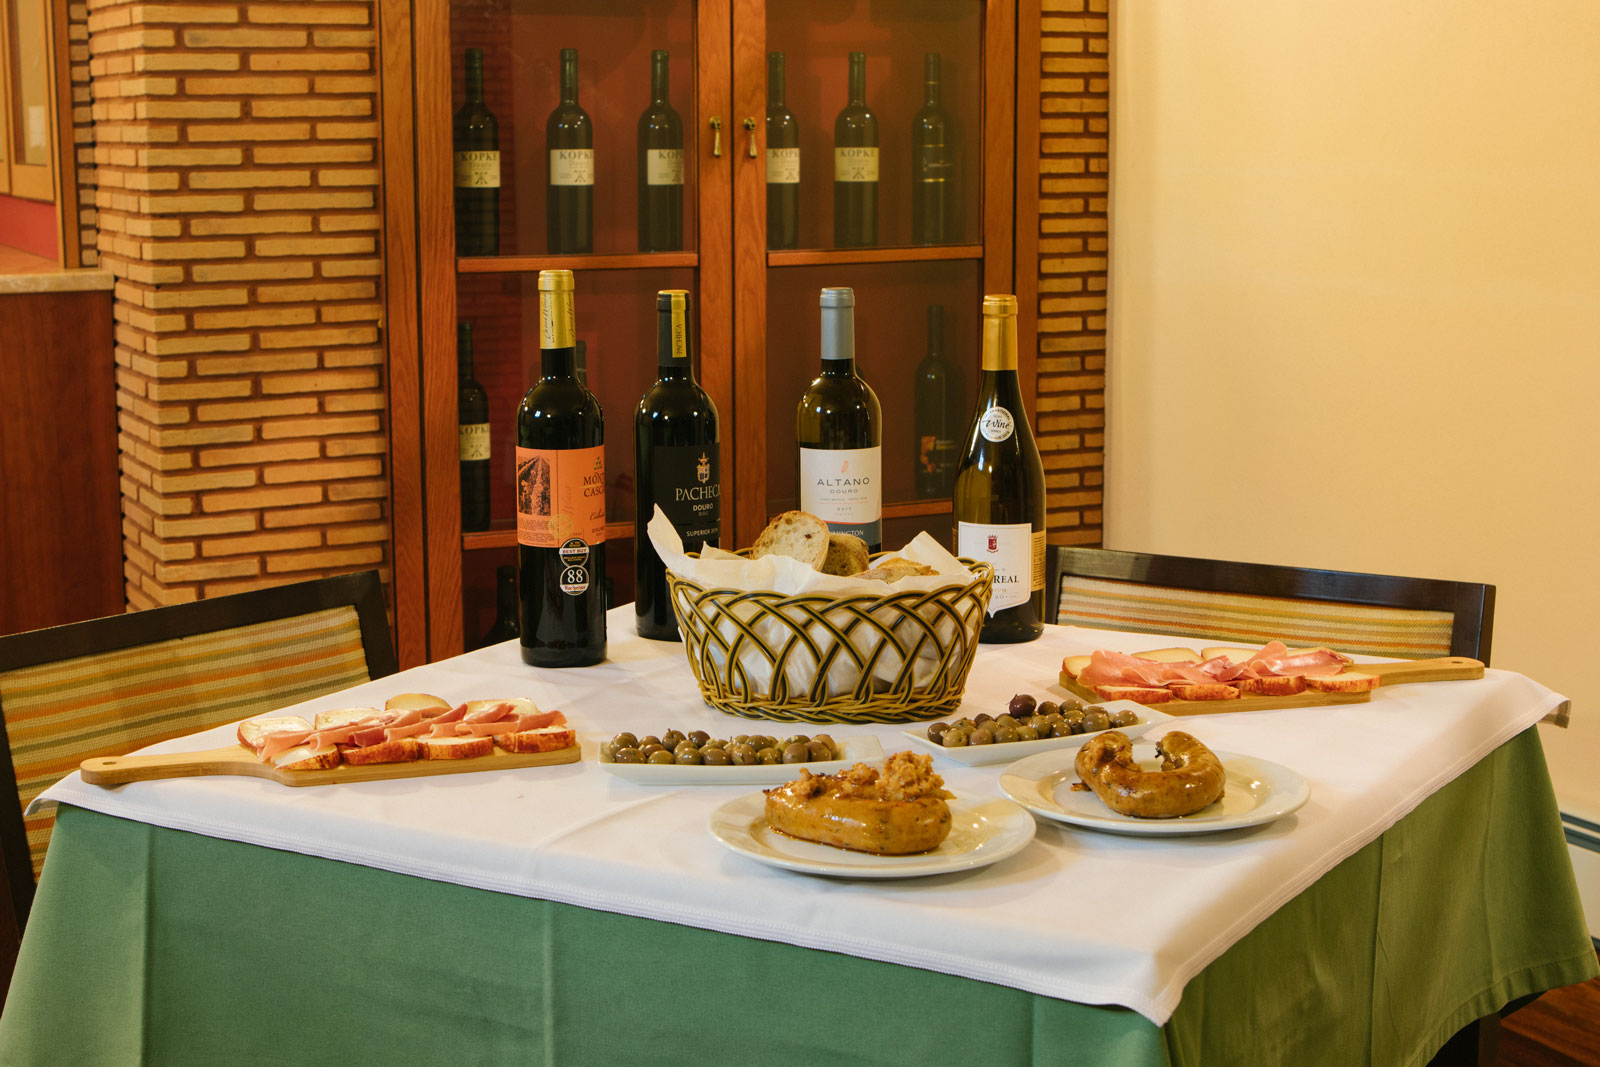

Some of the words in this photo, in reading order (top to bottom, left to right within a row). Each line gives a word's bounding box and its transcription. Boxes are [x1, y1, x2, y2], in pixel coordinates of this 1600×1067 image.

[817, 477, 870, 487] ALTANO
[692, 503, 714, 512] DOURO
[567, 569, 583, 584] 88
[993, 575, 1020, 584] REAL
